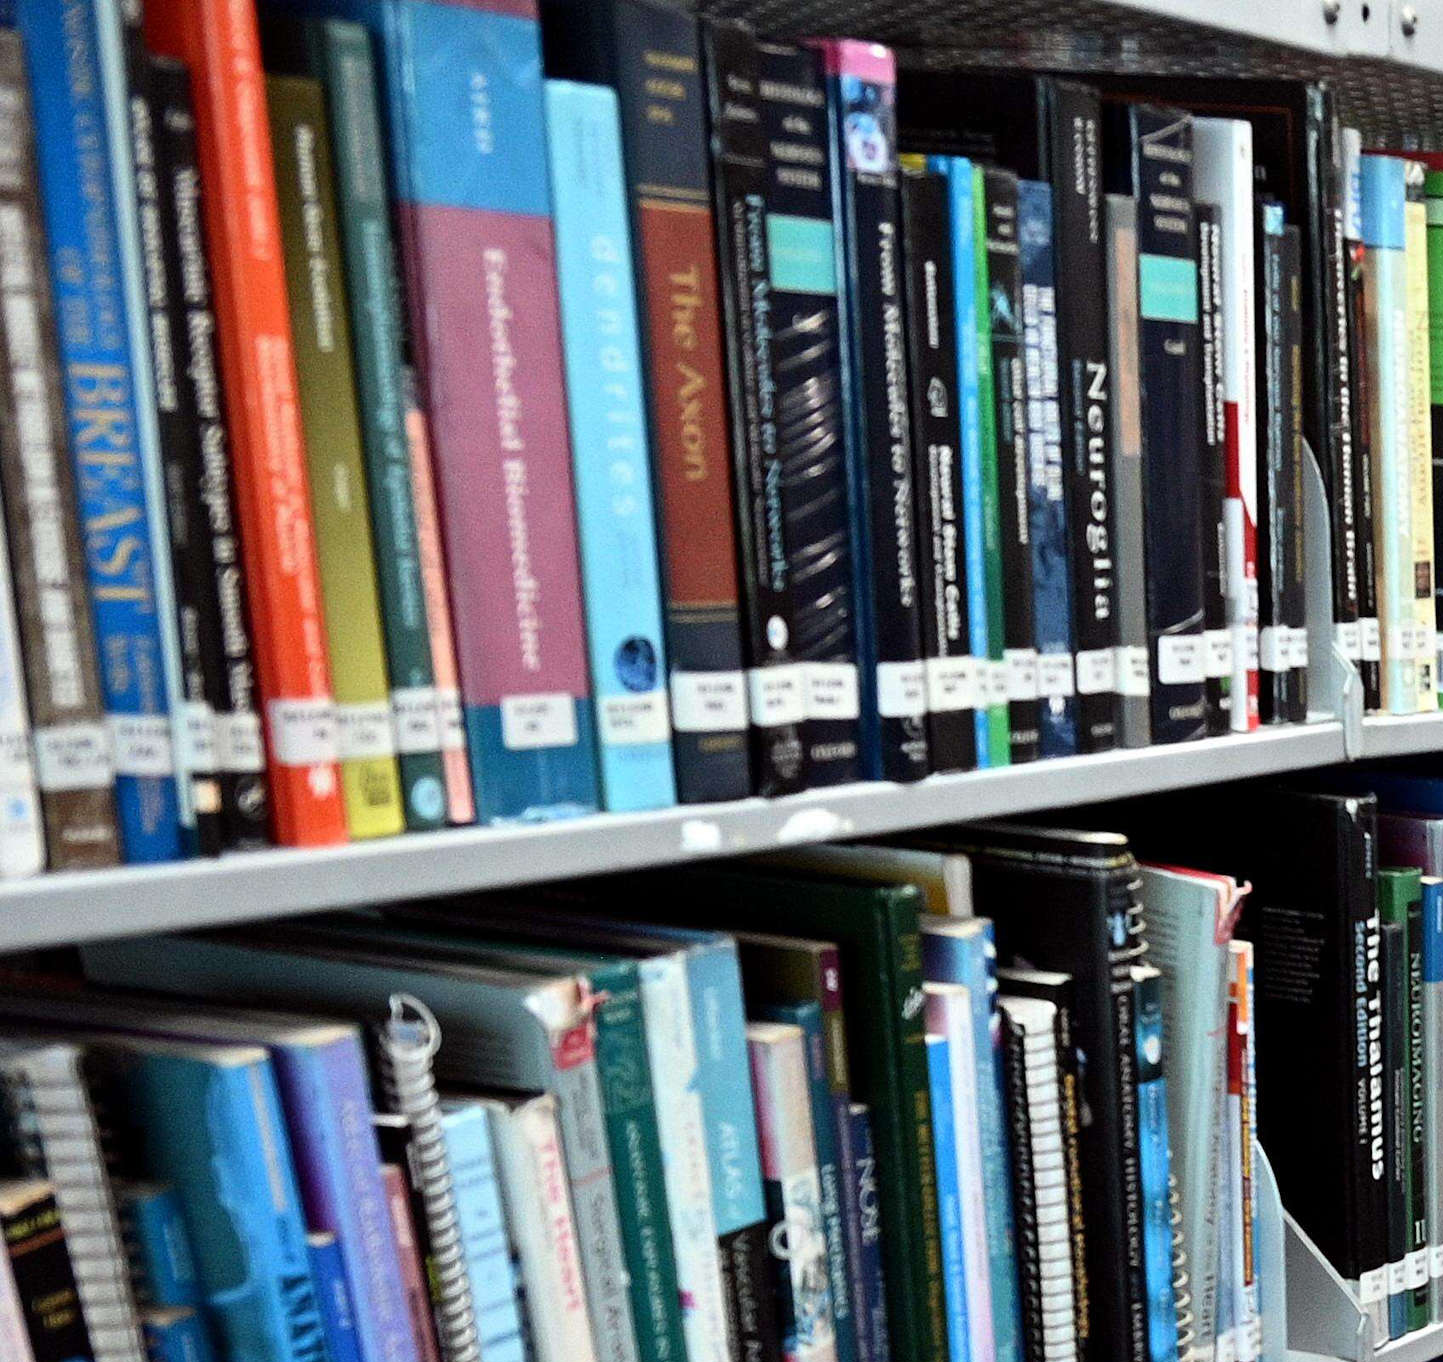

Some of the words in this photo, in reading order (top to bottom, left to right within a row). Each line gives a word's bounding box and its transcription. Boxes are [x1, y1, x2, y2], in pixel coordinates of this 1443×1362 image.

[746, 195, 766, 273] From
[879, 221, 896, 297] From
[1211, 225, 1222, 307] Neural
[483, 251, 524, 453] Endothelial
[671, 265, 704, 350] The
[753, 280, 778, 420] Molecules
[1213, 312, 1224, 379] Stem
[590, 236, 641, 528] dendrites
[679, 364, 709, 479] Axon
[882, 302, 905, 440] Molecules
[1215, 382, 1226, 442] Cells
[66, 361, 152, 612] BREAST
[763, 459, 789, 595] Networks
[939, 444, 954, 521] Neural
[1085, 360, 1111, 621] Neuroglia
[503, 459, 543, 673] Biomedicine
[894, 479, 915, 608] Networks
[943, 523, 958, 582] Stem
[945, 584, 961, 640] Cells
[1354, 920, 1367, 991] Second
[1367, 908, 1382, 984] The
[1355, 996, 1368, 1068] Edition
[1369, 990, 1385, 1181] Thalamus
[1410, 951, 1422, 1144] NEUROIMAGING
[541, 1139, 564, 1204] The
[553, 1215, 584, 1313] Heart
[721, 1121, 742, 1200] ATLAS
[734, 1236, 756, 1332] Vascular
[856, 1157, 879, 1245] NOSE
[827, 1217, 849, 1319] Mechanics
